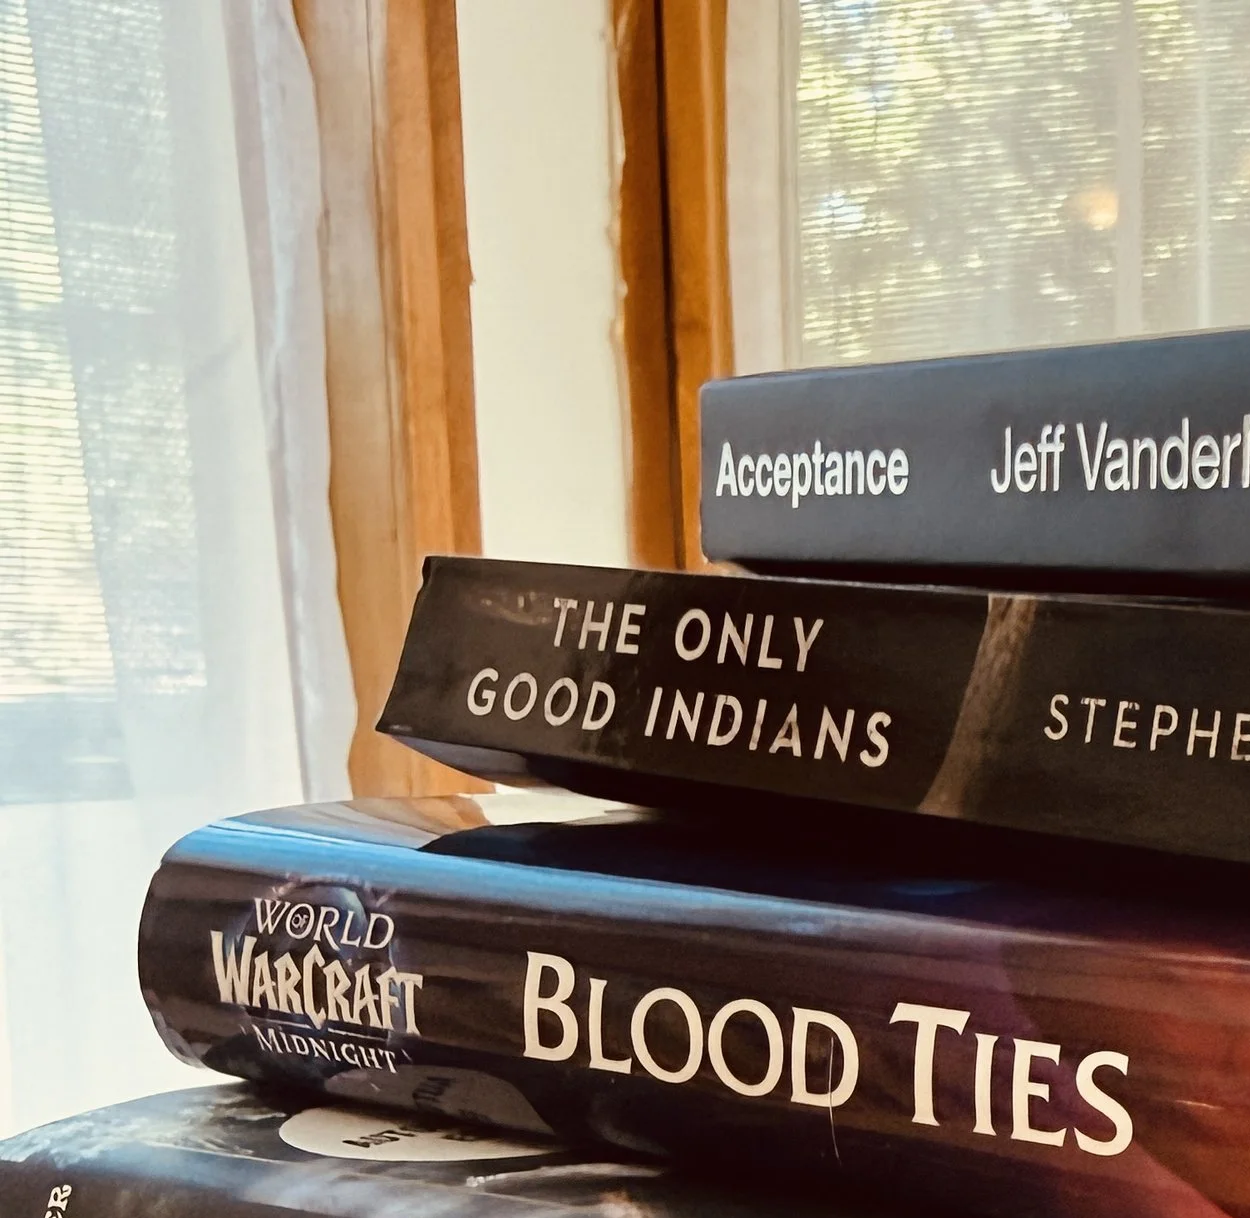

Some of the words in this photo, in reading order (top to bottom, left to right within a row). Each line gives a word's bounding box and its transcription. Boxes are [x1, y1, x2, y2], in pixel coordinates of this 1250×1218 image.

[715, 441, 909, 508] Acceptance
[990, 424, 1065, 494] Jeff
[552, 597, 646, 655] THE
[673, 608, 824, 673] ONLY
[466, 667, 616, 732] GOOD
[643, 686, 892, 769] INDIANS
[254, 897, 395, 950] WORLD
[254, 1024, 397, 1073] MIDNIGHT
[523, 951, 860, 1108] BLOOD
[889, 1002, 1134, 1156] TIES
